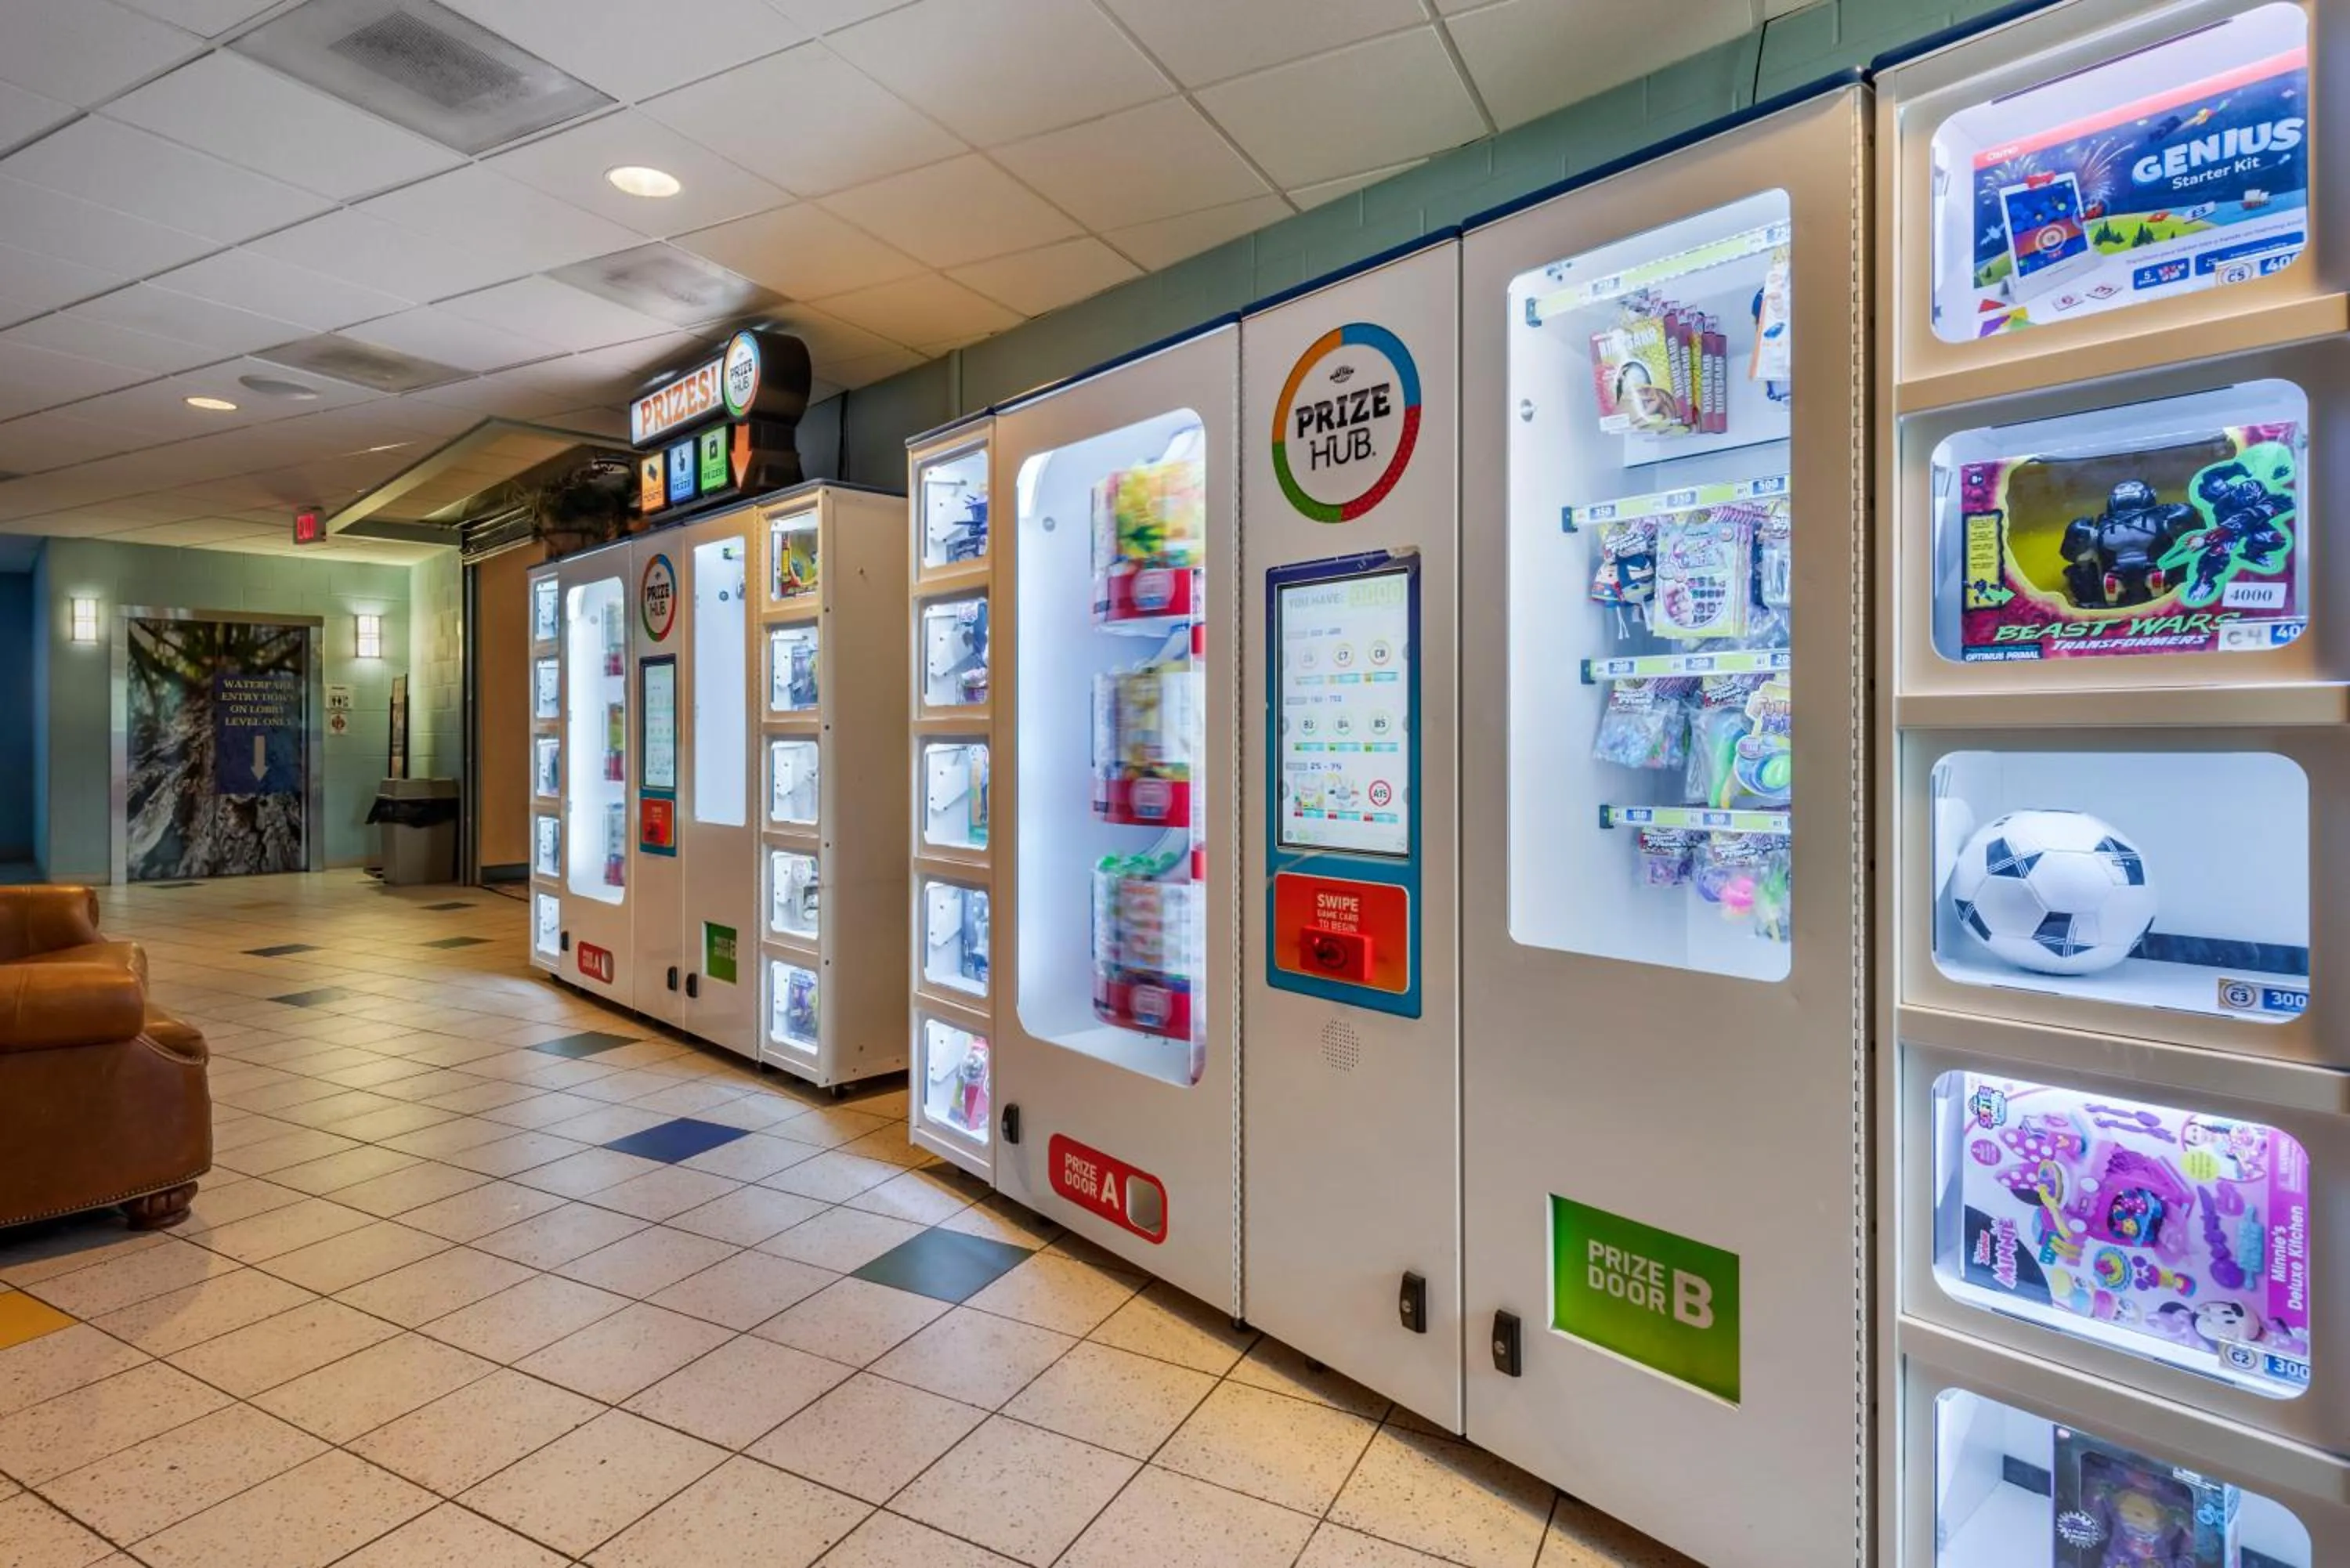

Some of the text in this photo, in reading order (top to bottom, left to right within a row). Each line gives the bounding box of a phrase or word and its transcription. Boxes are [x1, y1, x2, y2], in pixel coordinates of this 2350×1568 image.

[2131, 117, 2305, 185] GENIUS
[2172, 157, 2261, 190] Starter Kit
[2227, 269, 2246, 282] C5
[729, 358, 753, 381] PRIZE
[734, 375, 750, 392] HUB
[640, 365, 718, 436] PRIZES!
[1296, 383, 1390, 439] PRIZE
[646, 582, 670, 602] PRIZE
[1289, 596, 1309, 609] YOU
[2229, 587, 2273, 602] 4000
[1994, 612, 2241, 641] BEAST WARS
[2052, 633, 2208, 652] TRANSFORMERS
[1965, 649, 2039, 661] OPTIMUS PRIMAL
[223, 679, 294, 689] WATERPARK
[222, 692, 258, 701] ENTRY
[230, 704, 247, 714] ON
[225, 717, 258, 726] LEVEL
[1317, 893, 1360, 912] SWIPE
[1318, 919, 1358, 932] TO BEGIN
[2230, 989, 2248, 1002] C3
[1065, 1153, 1097, 1183] PRIZE
[1065, 1170, 1097, 1200] DOOR
[1101, 1171, 1119, 1211] A
[2287, 1205, 2305, 1259] Kitchen
[1588, 1239, 1666, 1289] PRIZE
[1993, 1217, 2019, 1288] MINNIE
[2271, 1226, 2287, 1282] Minnie's
[1588, 1264, 1667, 1315] DOOR
[2287, 1263, 2305, 1311] Deluxe
[1673, 1268, 1714, 1330] B
[2232, 1350, 2250, 1364] C2
